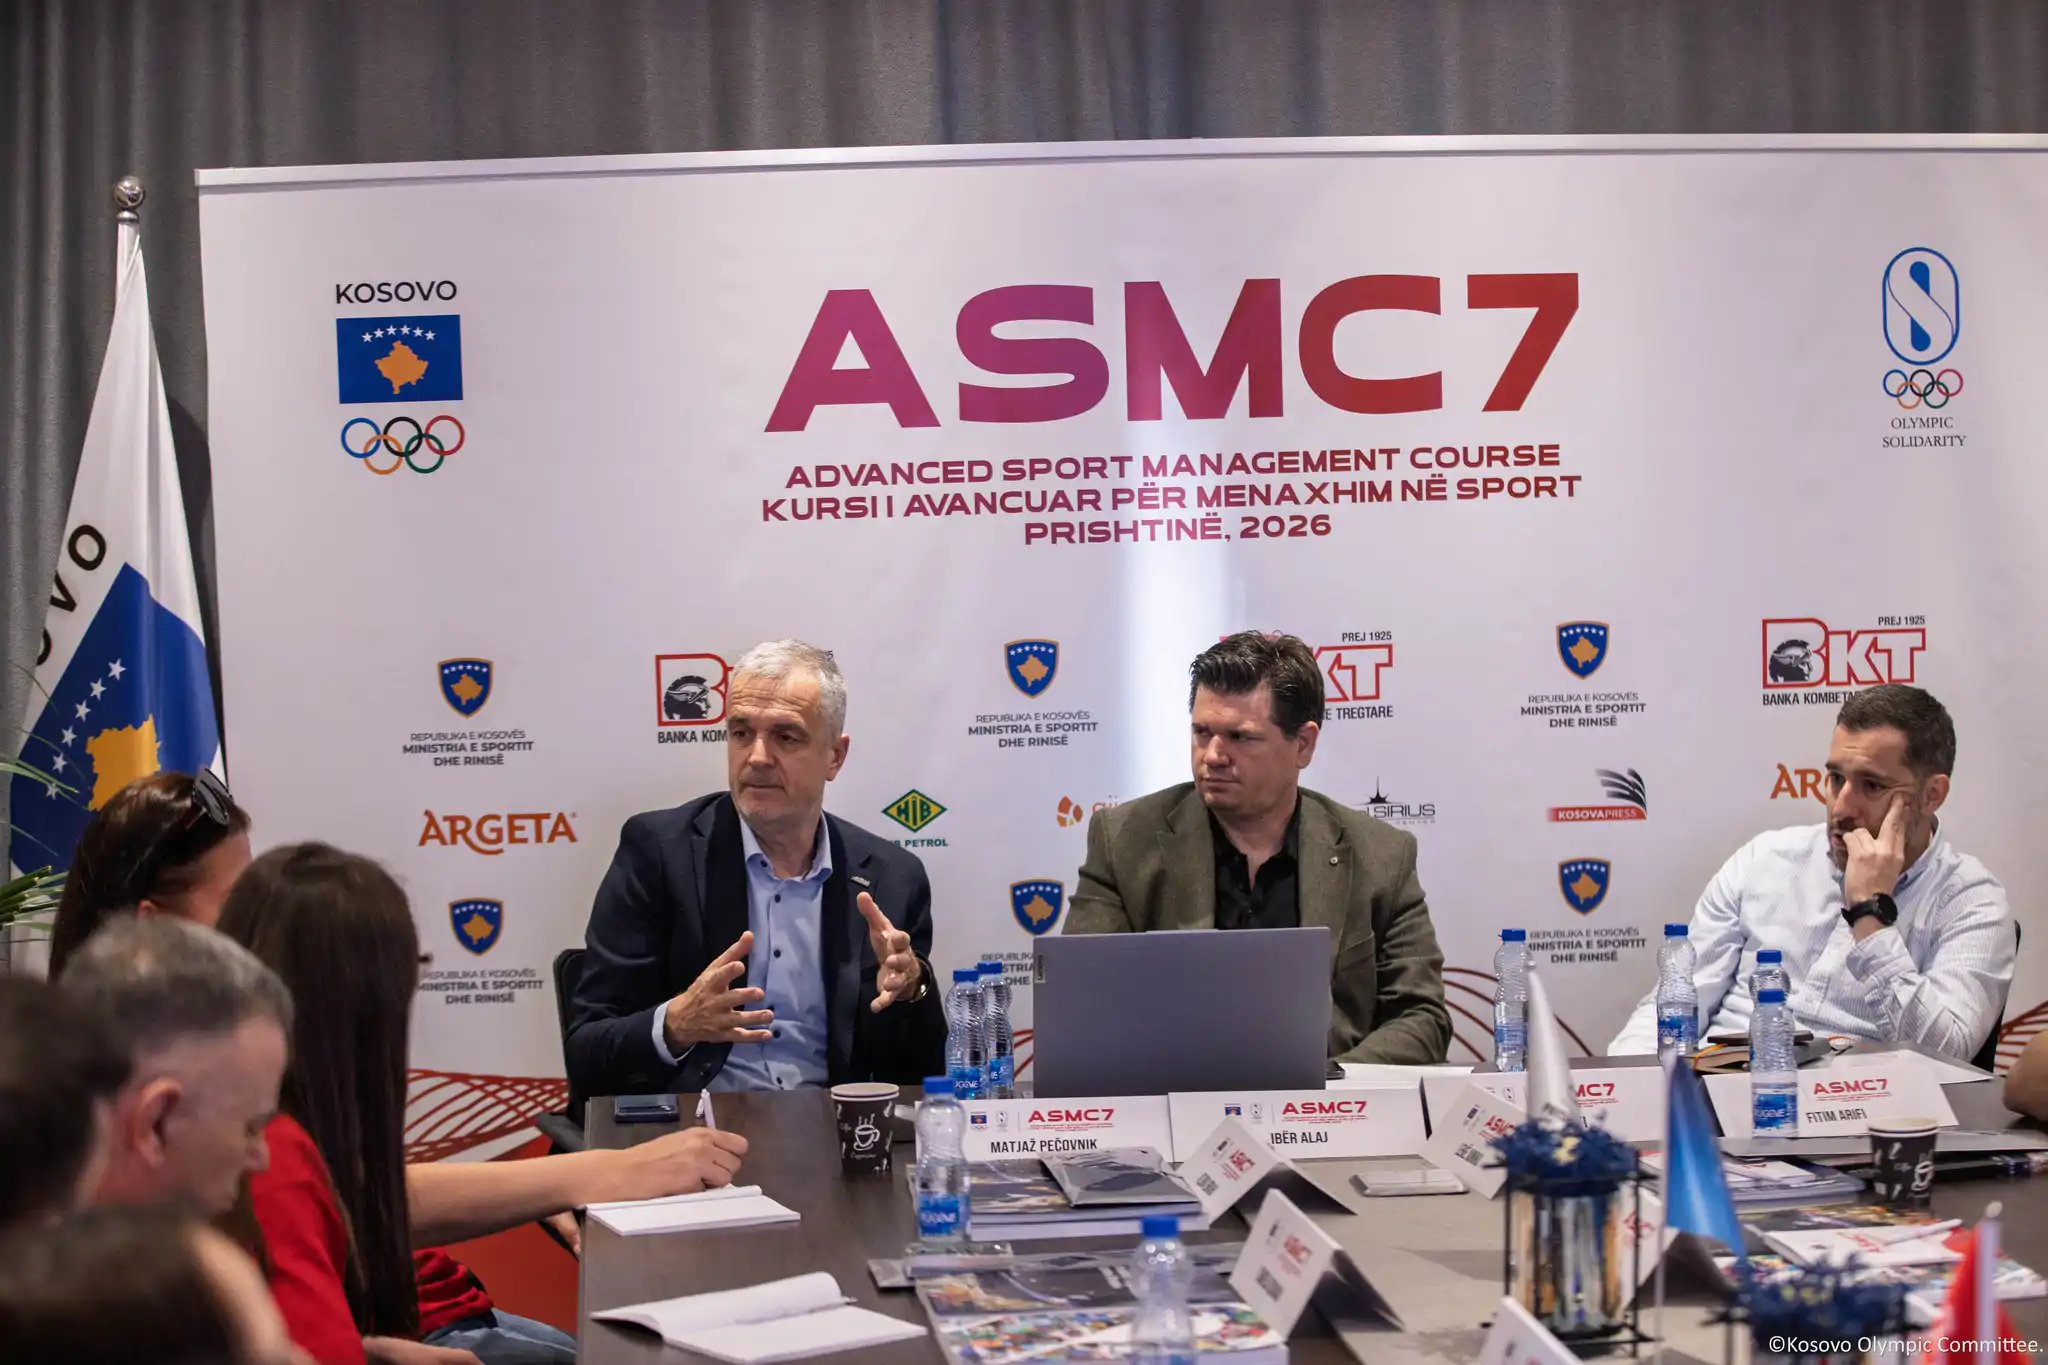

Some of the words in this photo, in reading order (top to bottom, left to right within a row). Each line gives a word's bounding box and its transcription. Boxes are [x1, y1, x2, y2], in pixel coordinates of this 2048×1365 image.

[335, 280, 457, 304] KOSOVO
[764, 273, 1579, 432] ASMC7
[1891, 417, 1954, 430] OLYMPIC
[1882, 435, 1967, 448] SOLIDARITY
[786, 460, 993, 488] ADVANCED
[1003, 456, 1133, 481] SPORT
[1142, 448, 1400, 477] MANAGEMENT
[1410, 444, 1560, 468] COURSE
[763, 496, 877, 521] KURSI
[886, 495, 894, 518] I
[904, 489, 1101, 516] AVANCUAR
[1112, 482, 1187, 510] PËR
[1196, 480, 1392, 508] MENAXHIM
[1401, 474, 1447, 501] NË
[1457, 475, 1582, 500] SPORT
[1025, 512, 1232, 545] PRISHTINË,
[1240, 514, 1332, 538] 2026
[1877, 616, 1901, 626] PREJ
[1905, 615, 1925, 625] 1925
[1342, 632, 1365, 642] PREJ
[1369, 631, 1392, 641] 1925
[1762, 617, 1926, 688] BKT
[1528, 694, 1582, 703] REPUBLIKA
[1585, 693, 1591, 701] E
[1763, 693, 1799, 705] BANKA
[1336, 706, 1393, 719] TREGTARE
[1521, 705, 1582, 715] MINISTRIA
[1585, 704, 1593, 713] E
[1595, 703, 1646, 713] SPORTIT
[976, 713, 1032, 723] REPUBLIKA
[1043, 710, 1090, 720] KOSOVËS
[1549, 718, 1575, 727] DHE
[1578, 715, 1618, 726] RINISË
[968, 725, 1031, 735] MINISTRIA
[1035, 724, 1042, 733] E
[1046, 722, 1098, 732] SPORTIT
[411, 733, 467, 741] REPUBLIKA
[469, 732, 476, 740] E
[658, 731, 697, 743] BANKA
[998, 738, 1025, 748] DHE
[1028, 736, 1068, 747] RINISË
[403, 743, 467, 754] MINISTRIA
[470, 743, 478, 752] E
[481, 741, 534, 751] SPORTIT
[433, 757, 460, 766] DHE
[464, 753, 504, 765] RINISË
[1770, 763, 1827, 805] AR
[1374, 804, 1436, 818] SIRIUS
[418, 810, 577, 855] ARGETA
[905, 839, 948, 847] PETROL
[1586, 928, 1592, 937] E
[1586, 940, 1594, 949] E
[1597, 938, 1647, 949] SPORTIT
[1551, 953, 1576, 963] DHE
[482, 981, 489, 990] E
[492, 980, 544, 990] SPORTIT
[446, 995, 472, 1004] DHE
[1814, 1079, 1887, 1094] ASMC7
[1282, 1101, 1367, 1114] ASMC7
[1028, 1109, 1115, 1122] ASMC7
[1806, 1111, 1836, 1123] FITIM
[1839, 1108, 1867, 1120] ARIFI
[1271, 1130, 1297, 1144] IBËR
[1301, 1131, 1328, 1143] ALAJ
[991, 1138, 1036, 1153] MATJAŽ
[1040, 1137, 1097, 1152] PEČOVNIK
